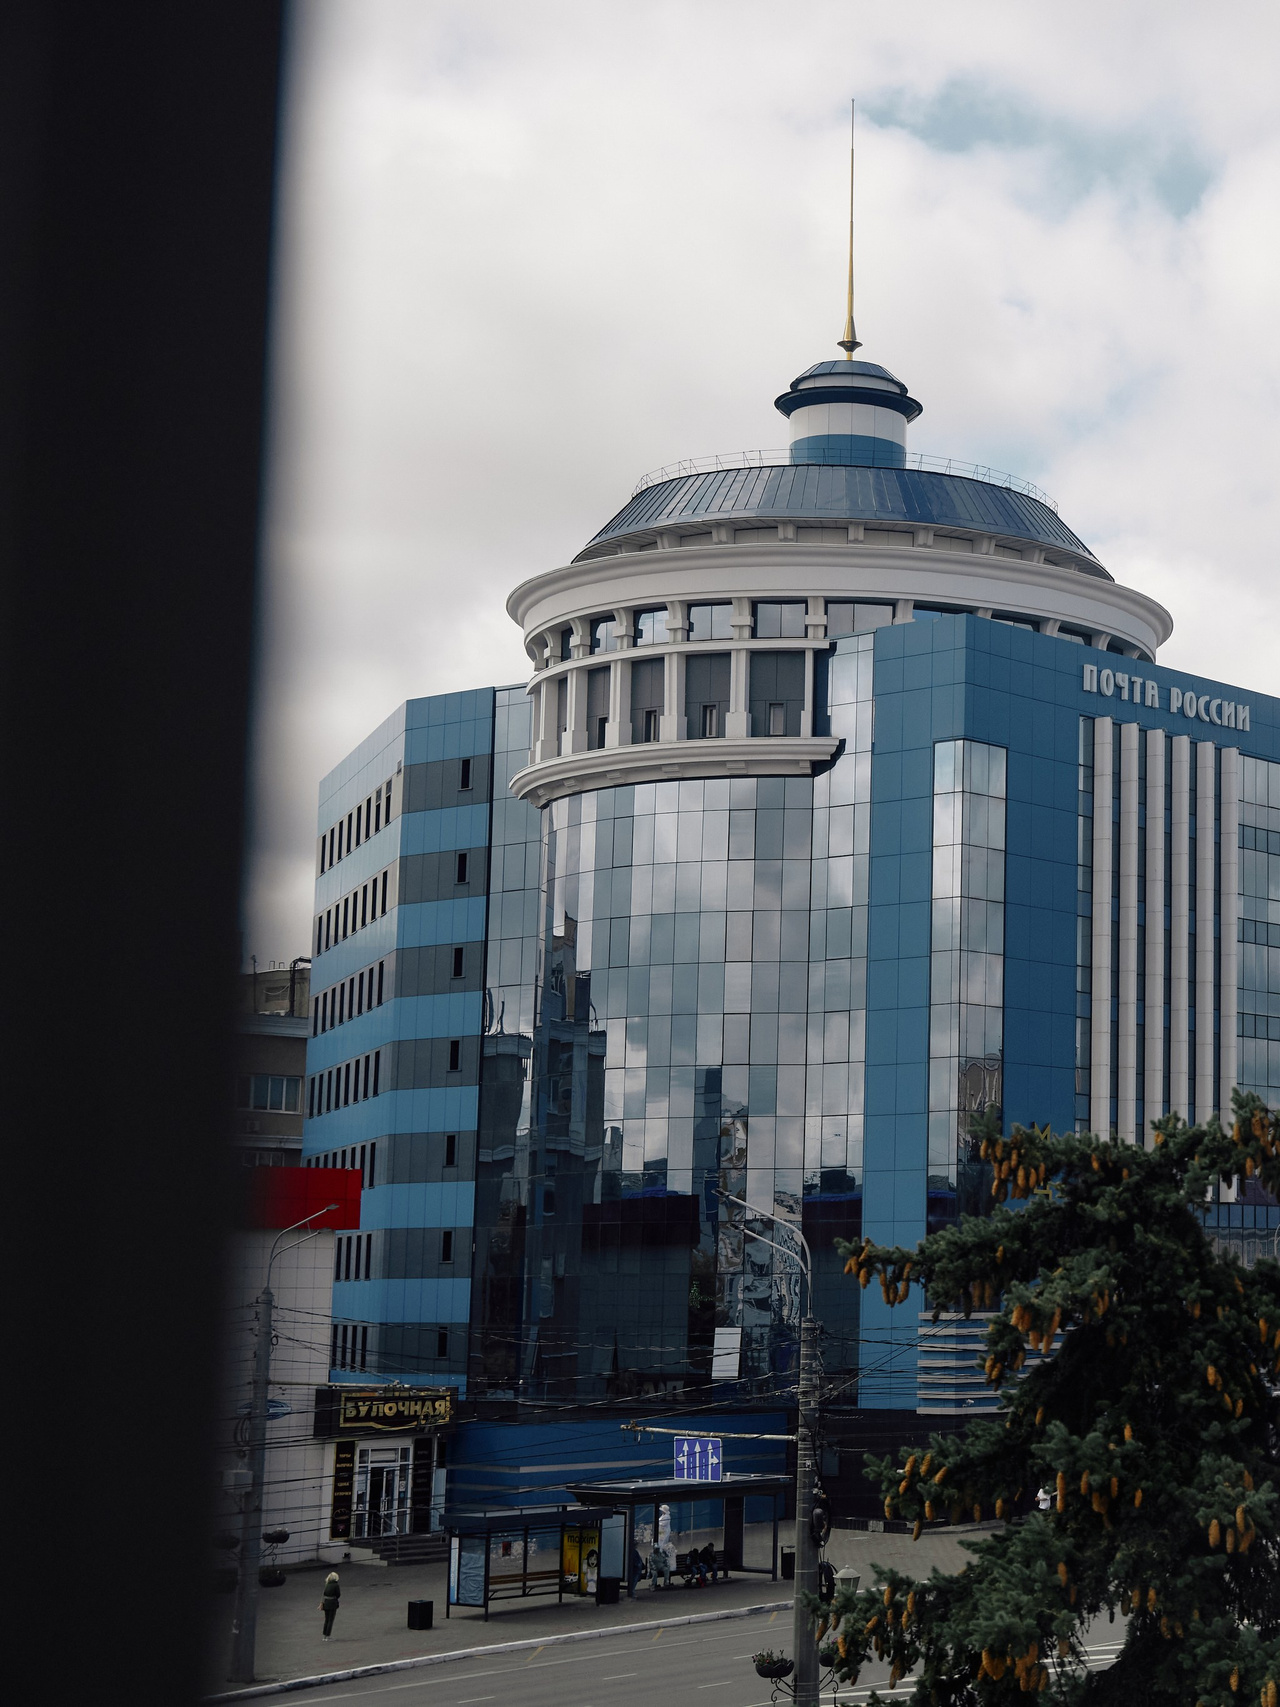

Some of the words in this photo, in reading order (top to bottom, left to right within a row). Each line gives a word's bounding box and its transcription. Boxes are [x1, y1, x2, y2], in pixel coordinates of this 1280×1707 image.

[1083, 664, 1159, 708] ПОЧТА
[1170, 687, 1250, 732] РОССИИ
[345, 1400, 446, 1418] БУЛОЧНАЯ
